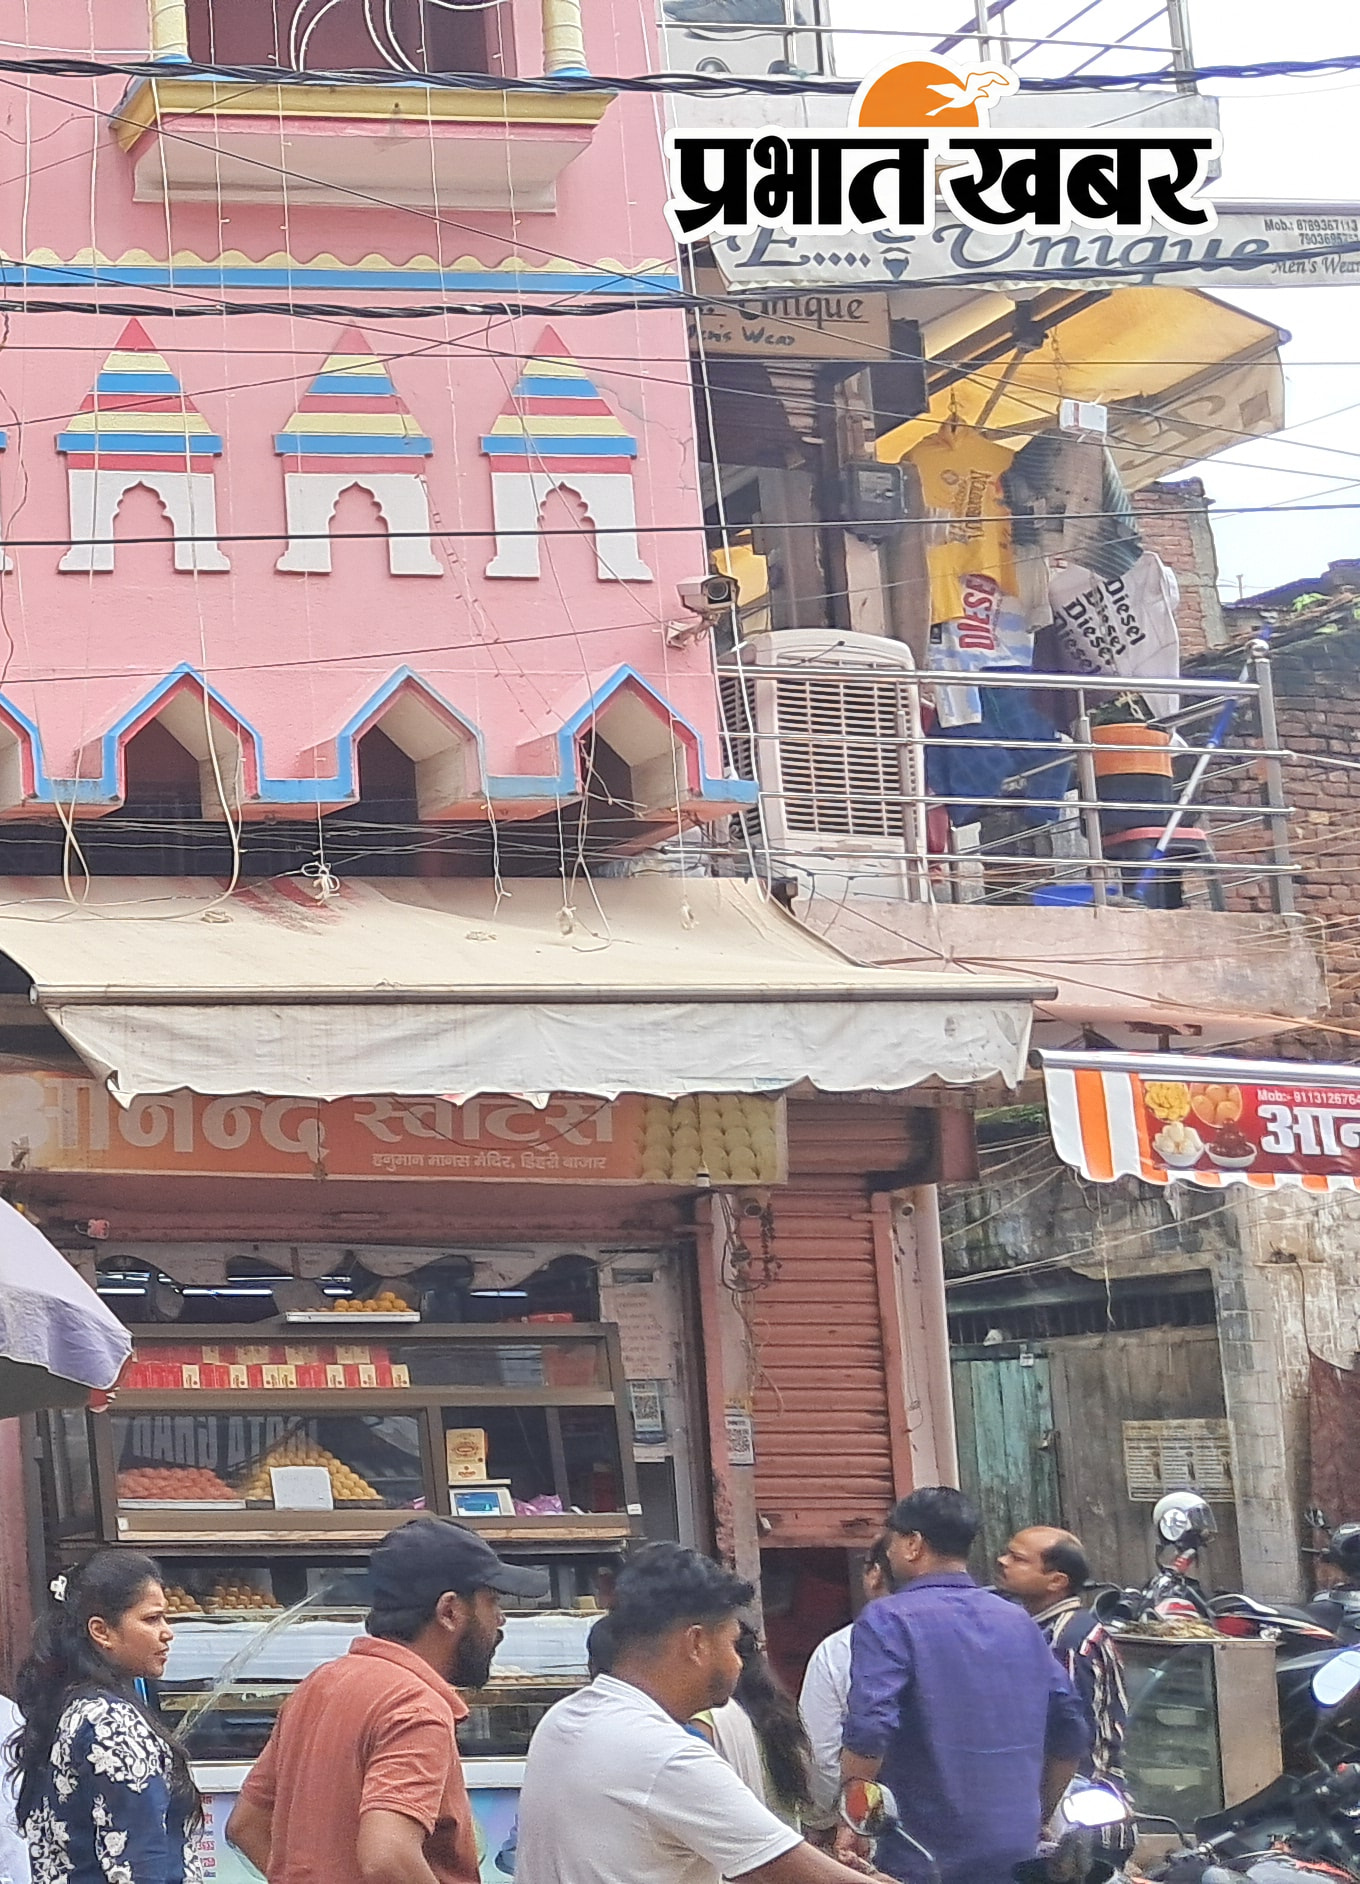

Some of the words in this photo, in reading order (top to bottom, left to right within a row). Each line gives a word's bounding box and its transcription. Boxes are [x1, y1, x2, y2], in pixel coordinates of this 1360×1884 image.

[1062, 597, 1113, 666] Diese
[1102, 576, 1146, 646] Diesel
[372, 1152, 425, 1172] हनुमान
[428, 1153, 471, 1168] मानस
[521, 1151, 560, 1170] डिहरी
[563, 1155, 607, 1169] बाजार
